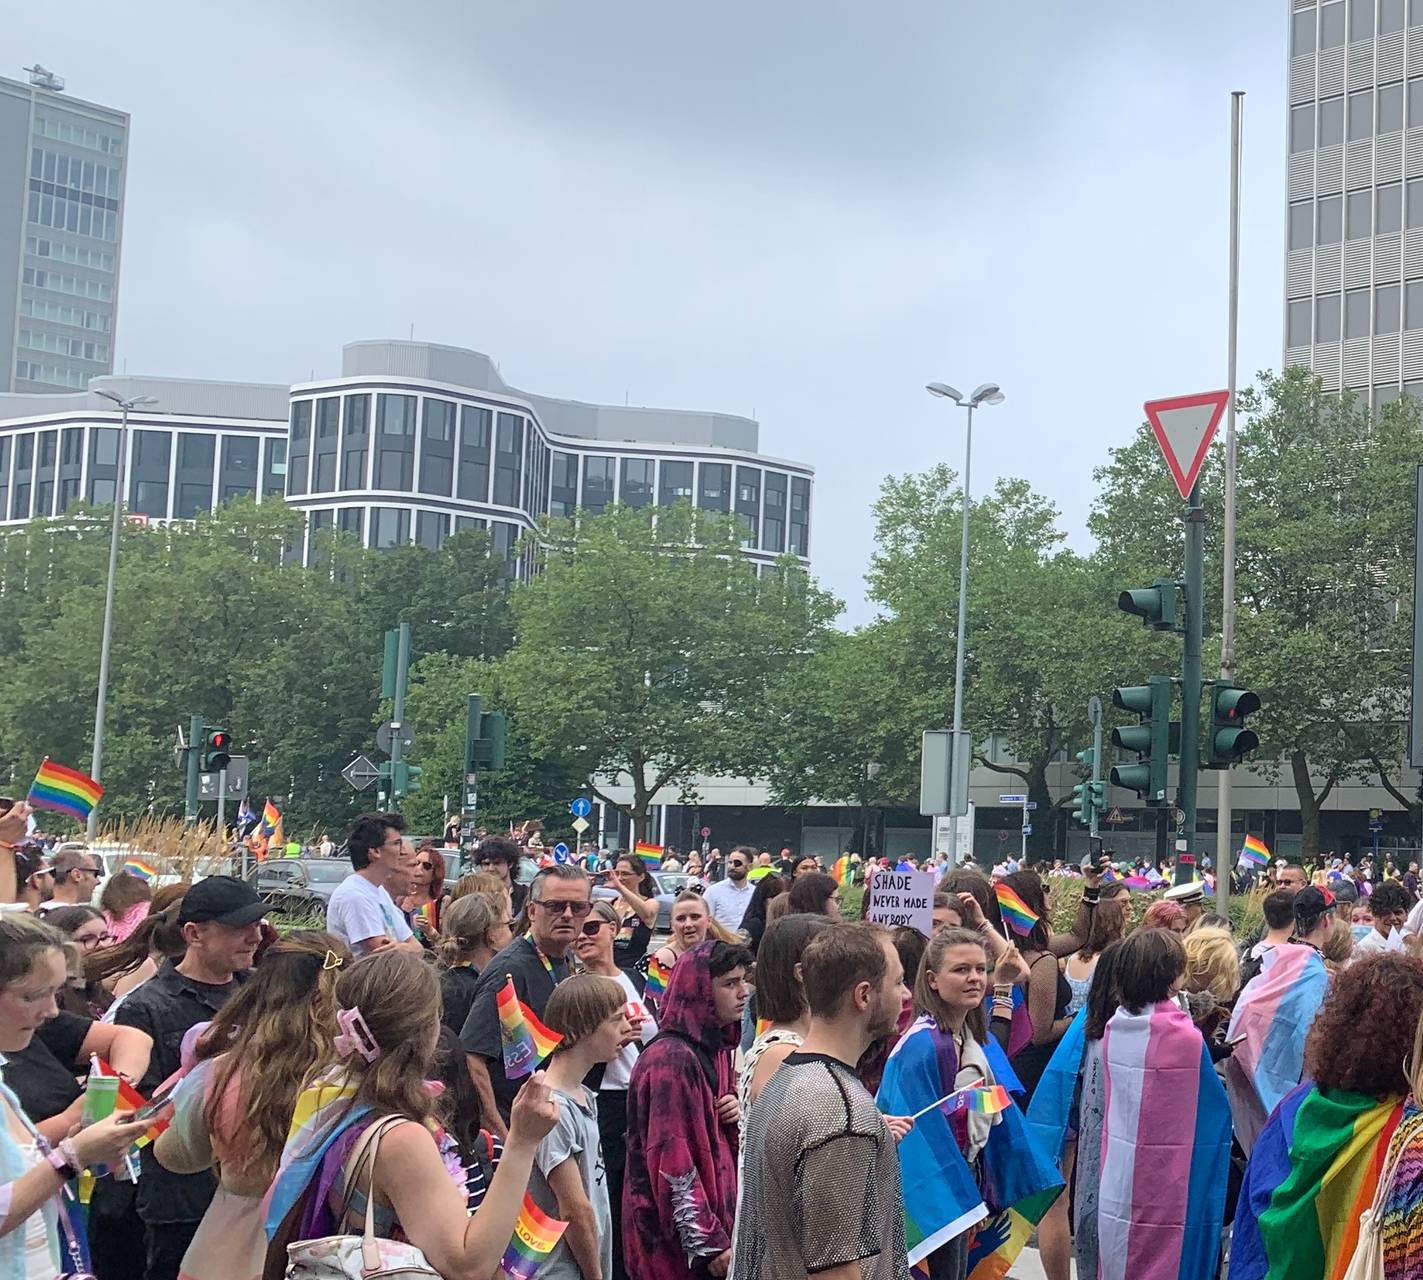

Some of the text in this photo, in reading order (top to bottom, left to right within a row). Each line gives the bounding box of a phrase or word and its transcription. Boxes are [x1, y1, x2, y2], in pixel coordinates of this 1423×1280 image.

[873, 874, 912, 891] SHADE
[873, 895, 928, 909] NEVER MADE
[872, 914, 913, 927] ANYBODY
